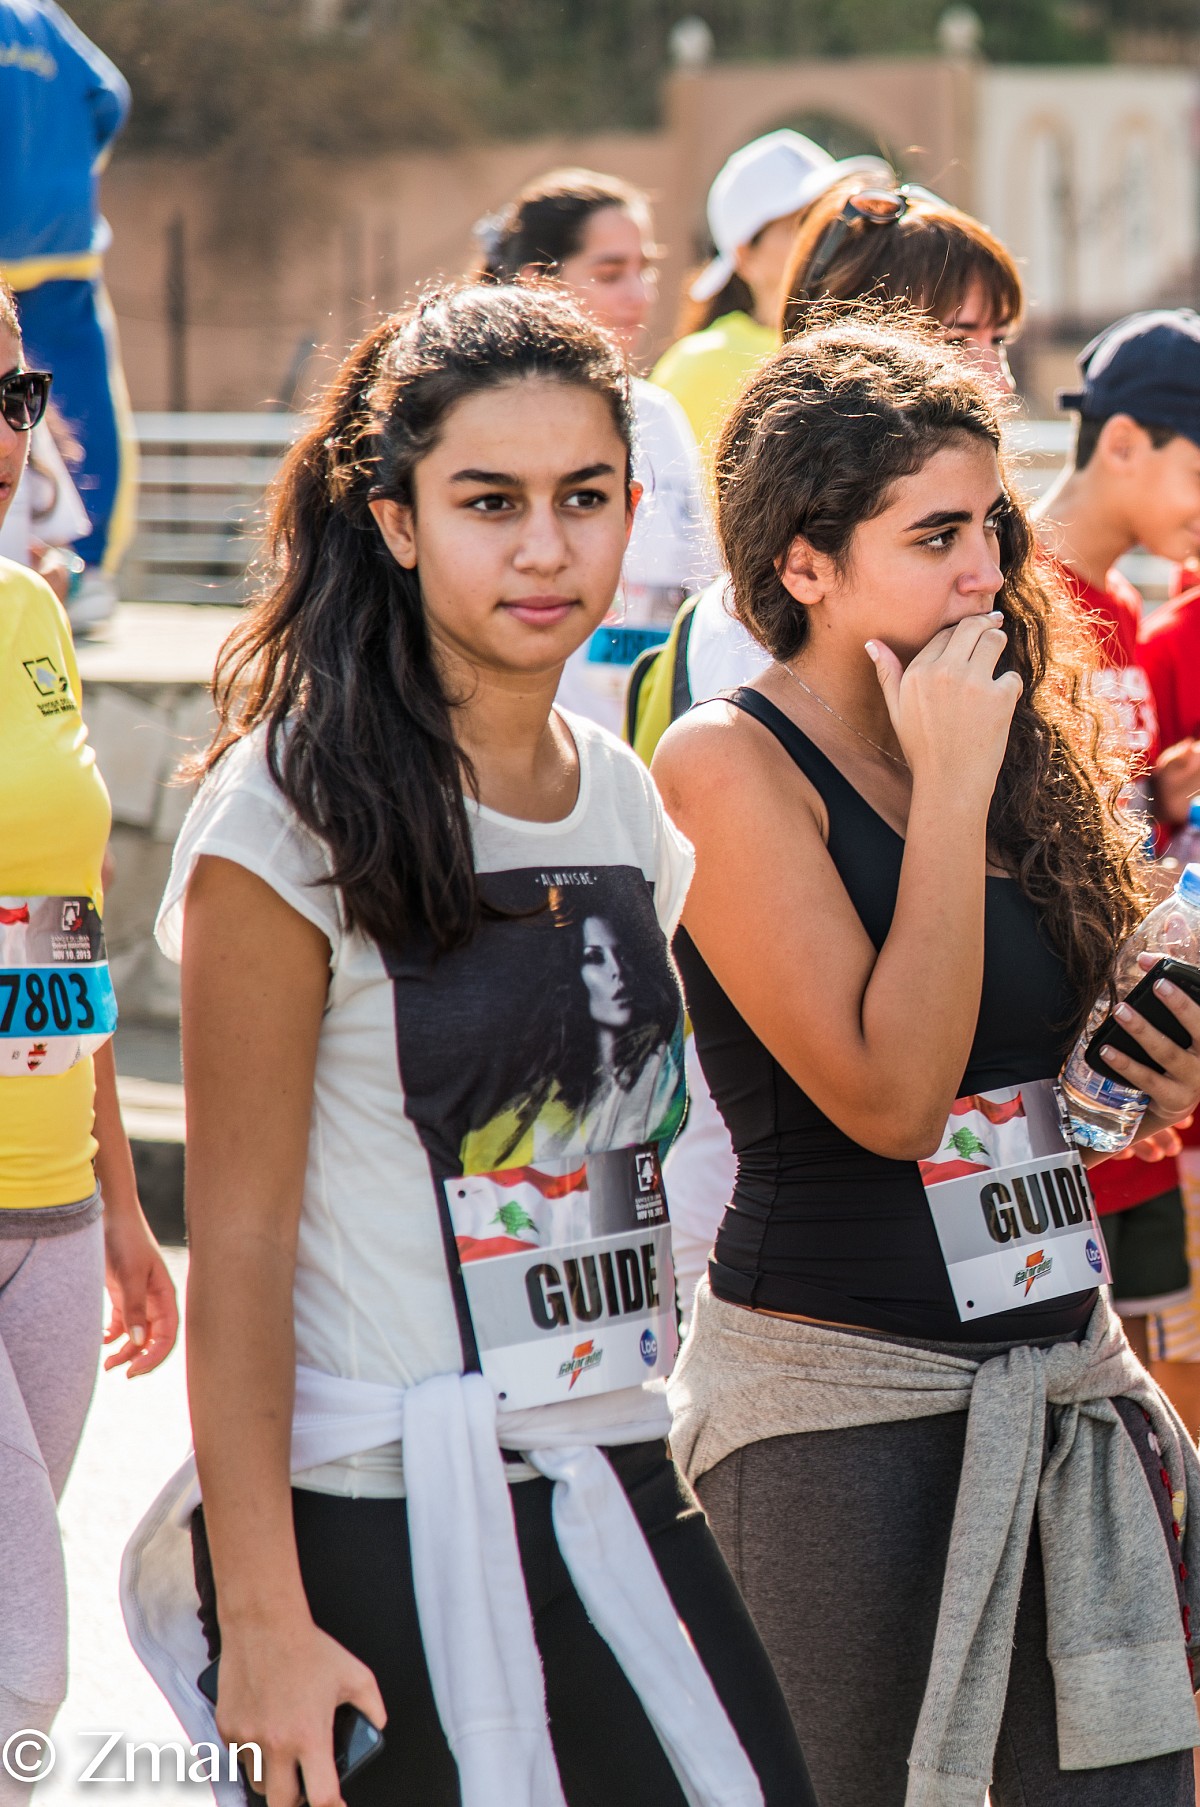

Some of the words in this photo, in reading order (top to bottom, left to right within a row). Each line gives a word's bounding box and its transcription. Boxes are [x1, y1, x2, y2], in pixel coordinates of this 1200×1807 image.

[0, 973, 94, 1032] 7803
[980, 1164, 1093, 1243] GUIDE
[524, 1243, 660, 1330] GUIDE
